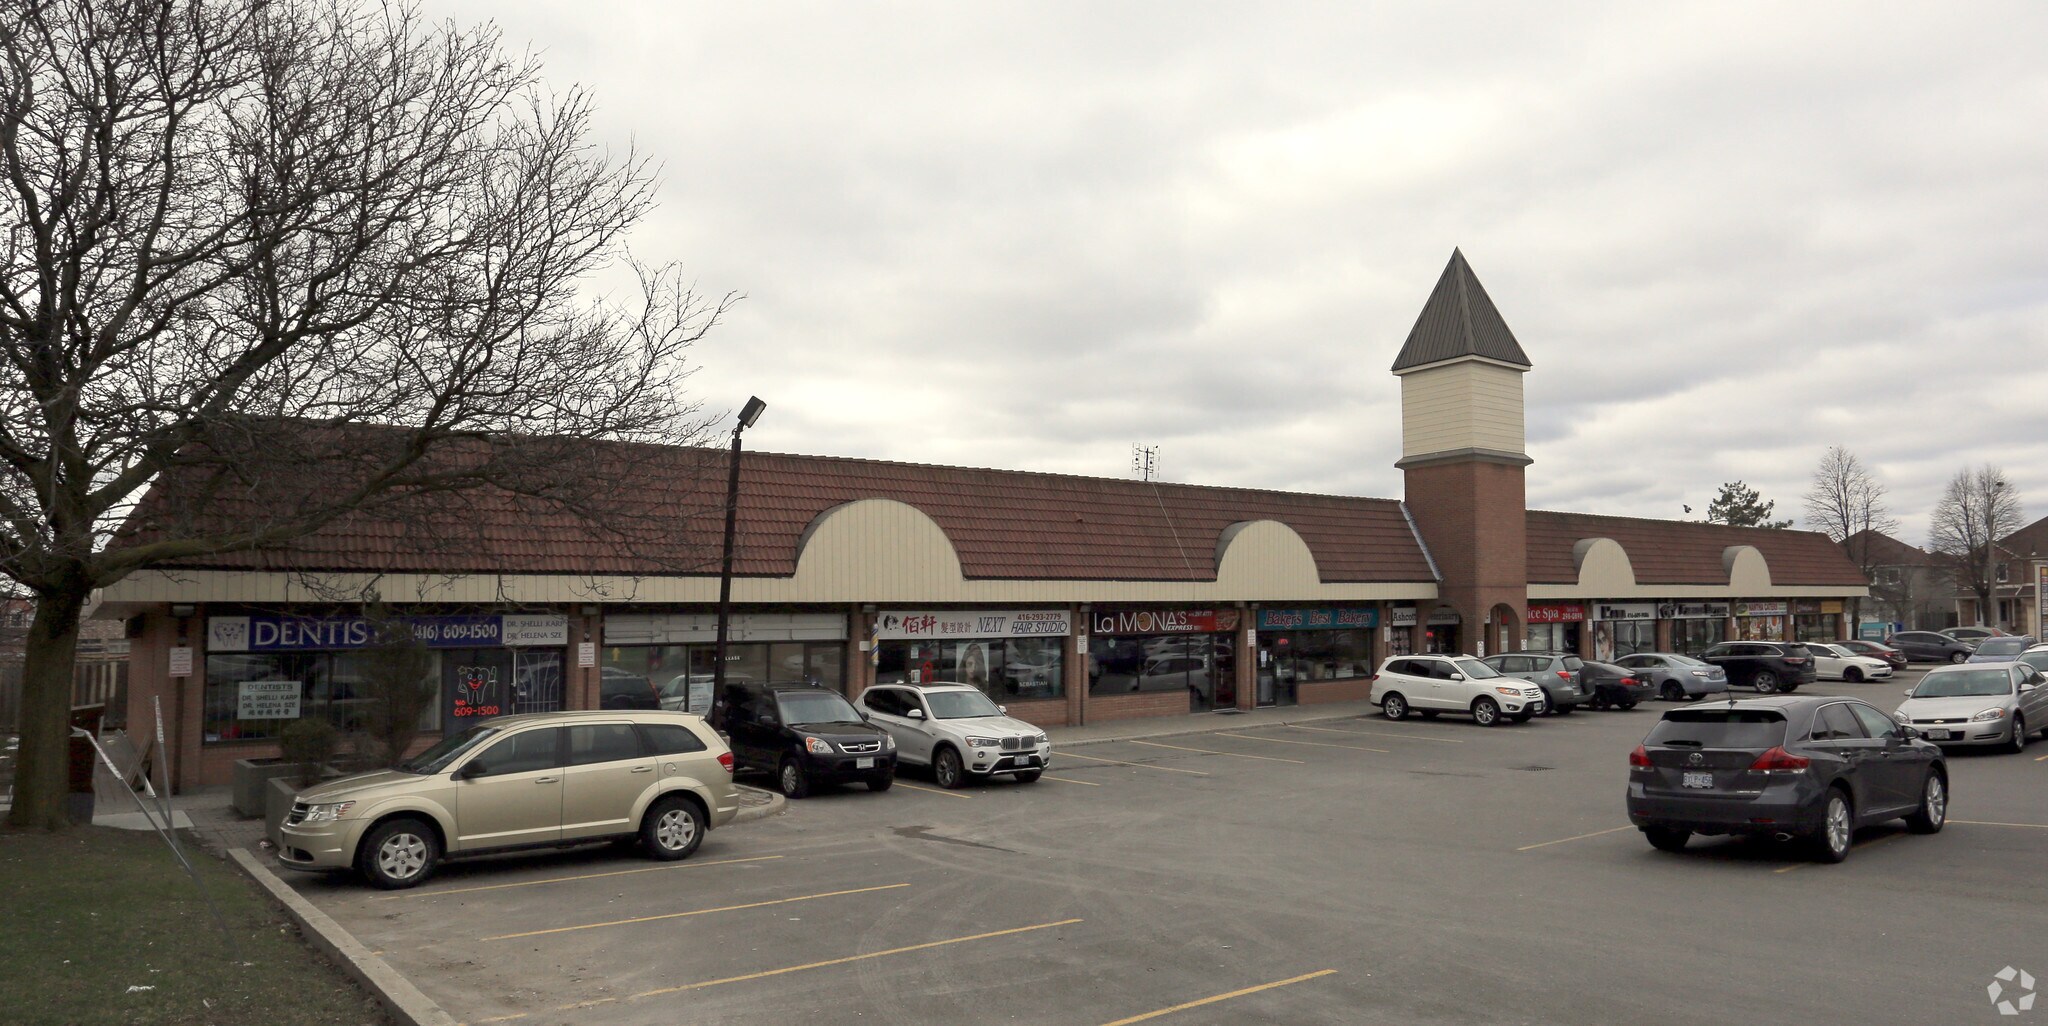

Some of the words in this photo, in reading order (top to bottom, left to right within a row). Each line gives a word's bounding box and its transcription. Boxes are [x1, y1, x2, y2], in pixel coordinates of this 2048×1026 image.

[1017, 613, 1062, 621] 416-293-2779
[1309, 610, 1332, 625] Best
[1337, 609, 1373, 627] Bakery
[1528, 608, 1540, 619] ice
[1542, 608, 1559, 620] Spa
[976, 616, 1006, 633] NEXT
[1011, 621, 1033, 634] HAIR
[1035, 620, 1068, 633] STUDIO
[1094, 612, 1114, 633] La
[1120, 611, 1187, 632] MONA'S
[255, 621, 368, 645] DENTIS
[443, 624, 498, 639] 609-1500
[454, 706, 499, 717] 609-1500
